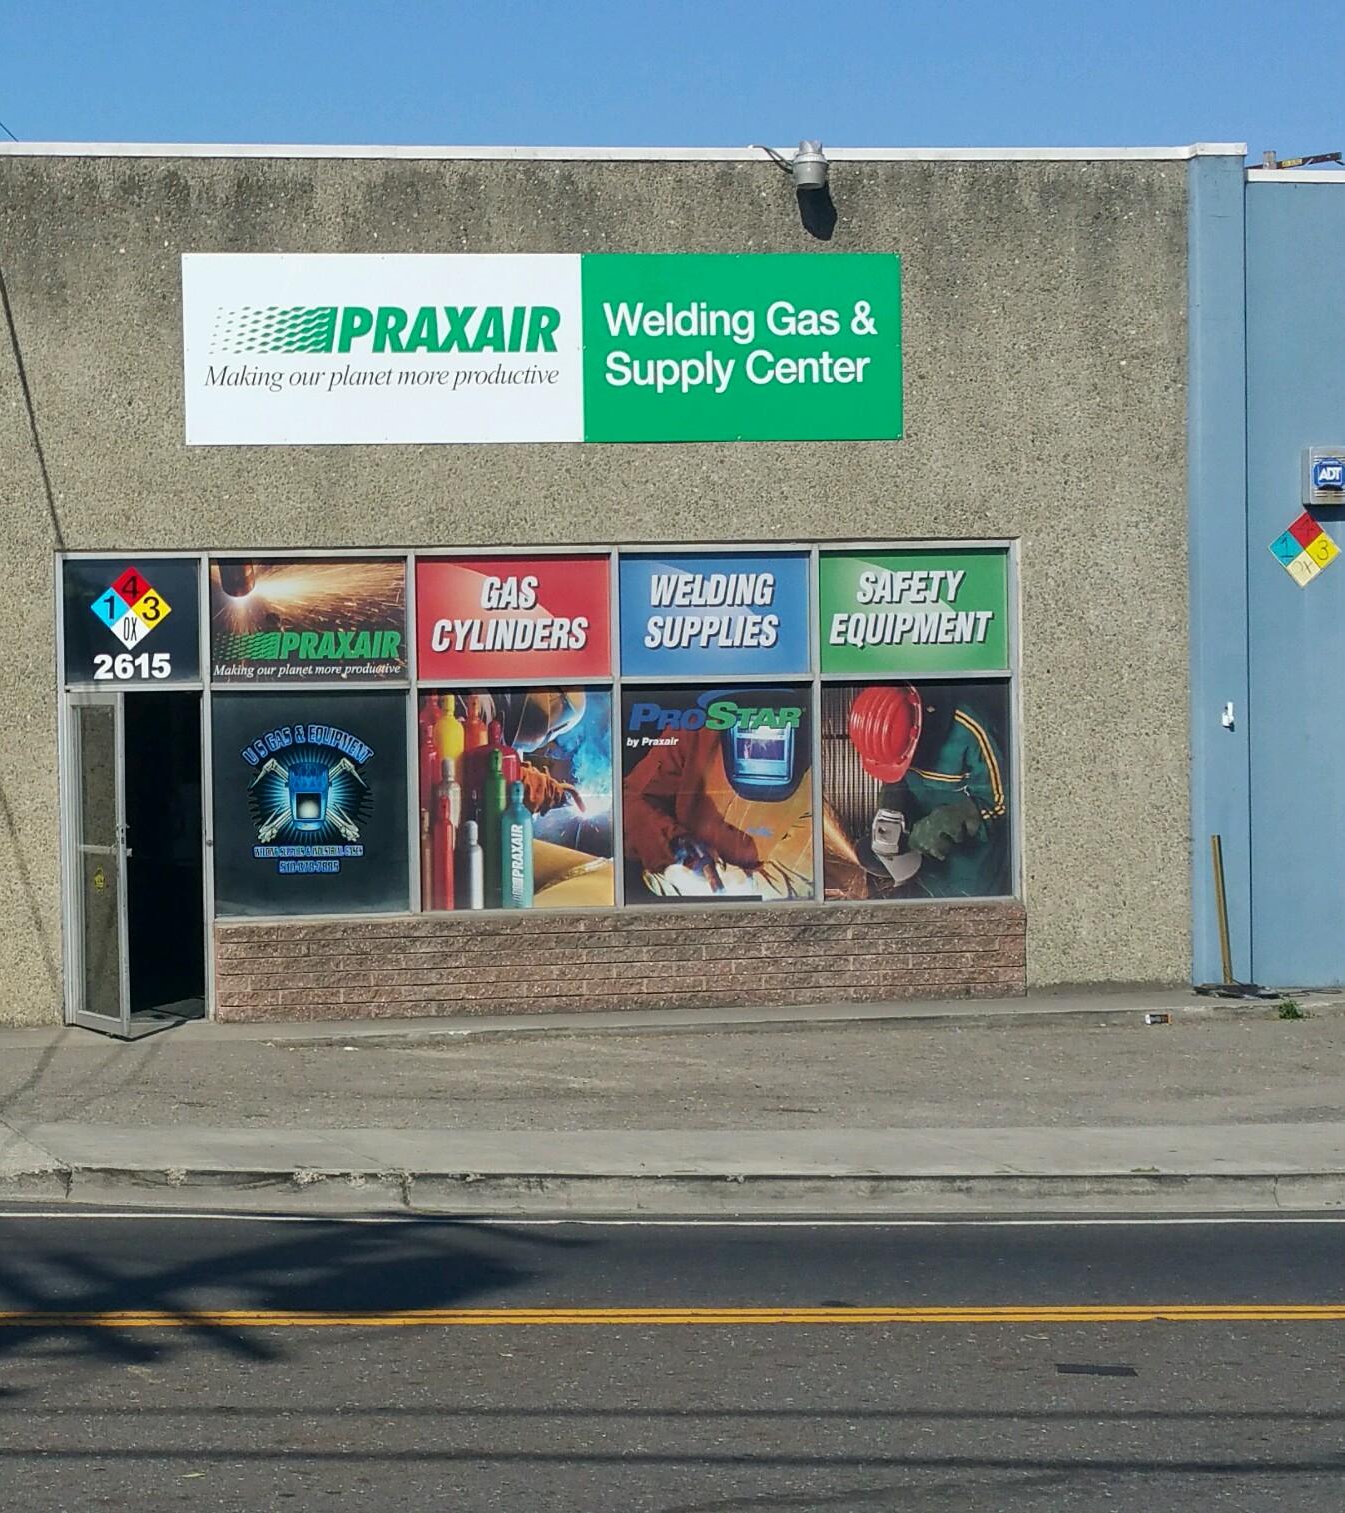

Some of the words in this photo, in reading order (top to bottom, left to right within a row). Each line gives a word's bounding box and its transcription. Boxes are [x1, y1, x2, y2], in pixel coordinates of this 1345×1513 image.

[337, 306, 561, 353] PRAXAIR
[603, 302, 755, 345] Welding
[766, 301, 841, 336] Gas
[850, 300, 878, 335] &
[204, 364, 285, 392] Making
[289, 371, 325, 387] our
[327, 364, 393, 392] planet
[397, 370, 450, 386] more
[452, 363, 560, 391] productive
[605, 350, 735, 394] Supply
[746, 349, 871, 385] Center
[1318, 466, 1342, 481] ADT
[1280, 536, 1294, 559] 1
[1317, 540, 1329, 561] 3
[121, 575, 140, 598] 4
[480, 576, 538, 610] GAS
[650, 573, 775, 607] WELDING
[856, 570, 966, 604] SAFETY
[102, 595, 115, 620] 1
[142, 596, 160, 621] 3
[123, 616, 137, 641] OX
[431, 617, 589, 652] CYLINDERS
[644, 615, 779, 648] SUPPLIES
[829, 611, 993, 649] EQUIPMENT
[280, 631, 401, 660] PRAXAIR
[93, 652, 172, 680] 2615
[213, 664, 255, 678] Making
[257, 668, 275, 676] our
[277, 664, 313, 678] planet
[315, 667, 342, 675] more
[344, 663, 401, 677] productive
[242, 747, 259, 766] U
[264, 727, 292, 752] GAS
[295, 725, 306, 743] &
[307, 725, 374, 764] EQUIPMENT
[626, 737, 639, 748] by
[641, 737, 679, 747] Praxair
[511, 823, 524, 878] PRAXAIR
